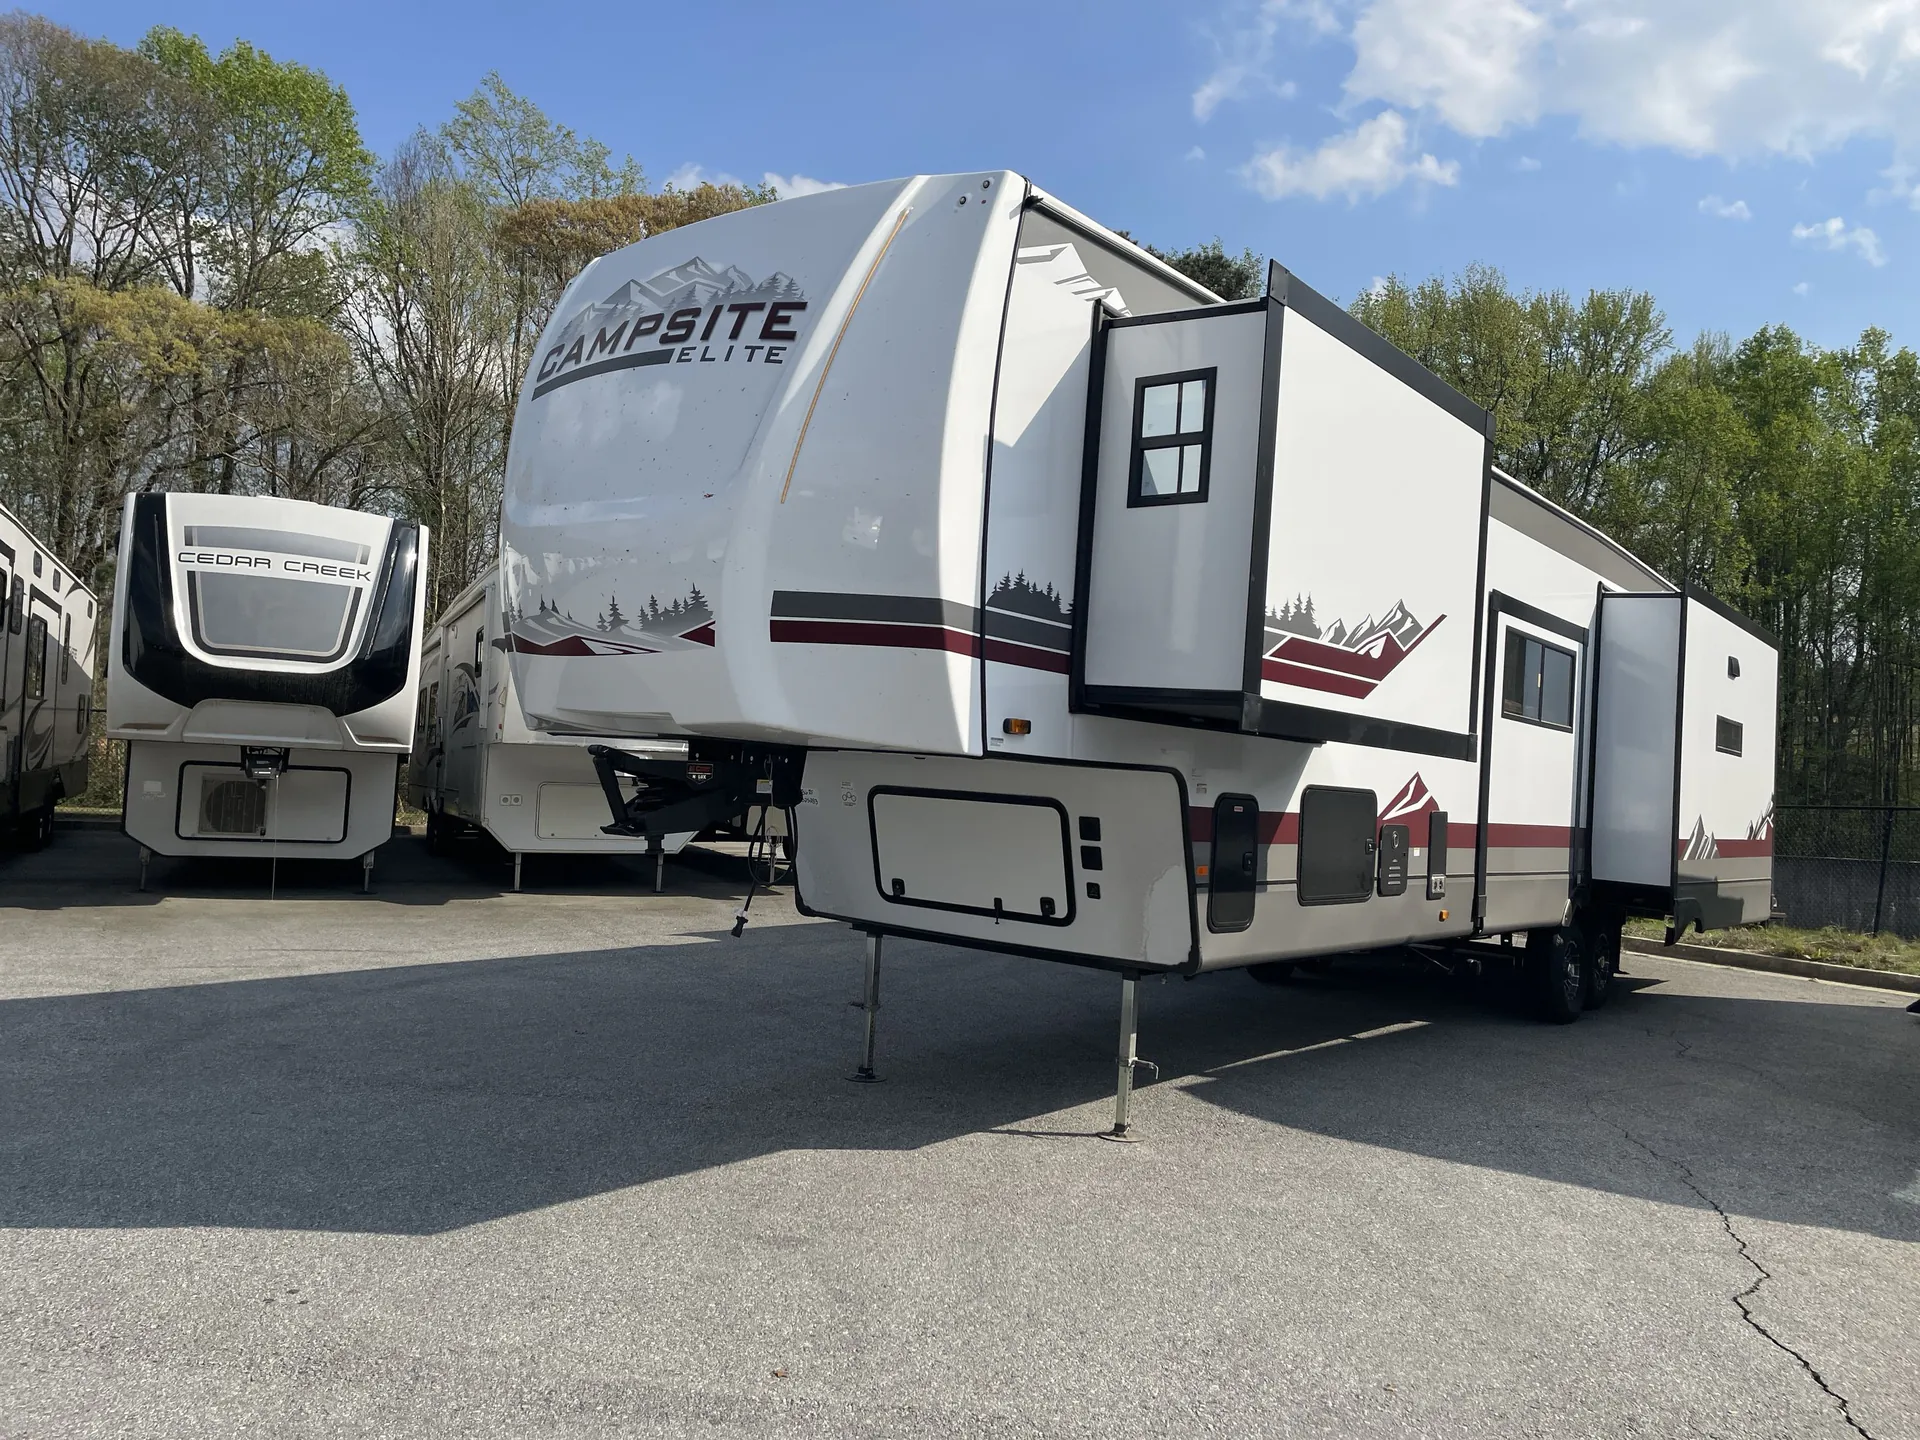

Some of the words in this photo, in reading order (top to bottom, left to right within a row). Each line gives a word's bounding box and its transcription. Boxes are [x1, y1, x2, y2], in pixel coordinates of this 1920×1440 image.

[537, 301, 808, 383] CAMPSITE
[676, 345, 787, 364] ELITE
[178, 552, 271, 569] CEDAR
[283, 560, 372, 581] CREEK
